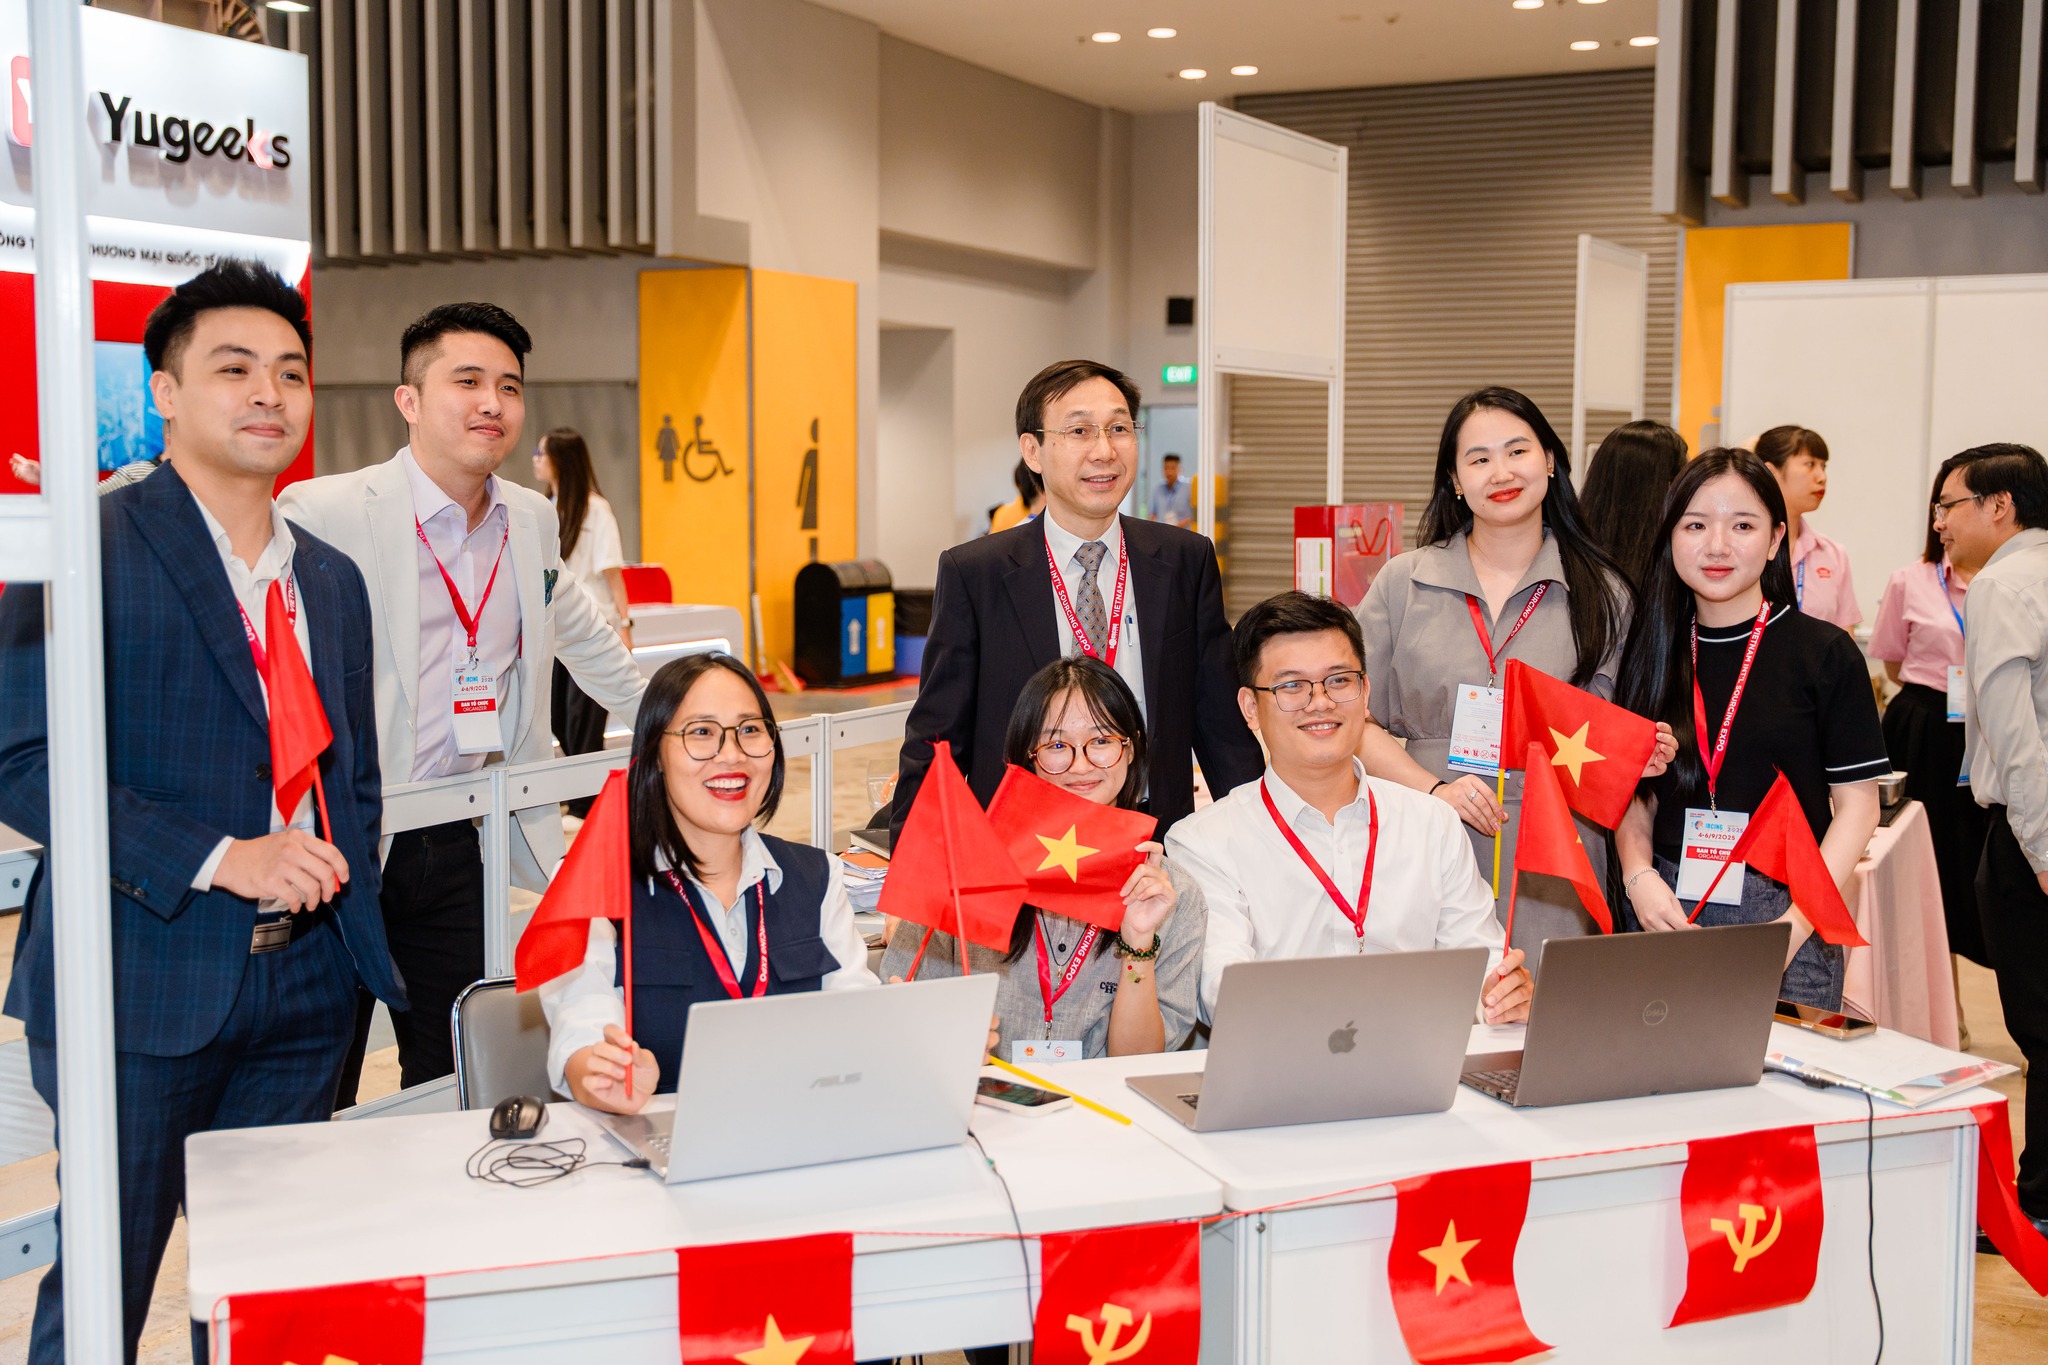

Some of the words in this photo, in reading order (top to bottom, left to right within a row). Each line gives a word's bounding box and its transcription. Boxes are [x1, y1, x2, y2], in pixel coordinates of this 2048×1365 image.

[99, 91, 291, 169] Yugeeks
[1113, 582, 1124, 618] VIETNAM
[1119, 561, 1127, 580] INT'L
[1522, 584, 1546, 619] SOURCING
[1050, 570, 1063, 590] INT'L
[1058, 590, 1078, 629] SOURCING
[1075, 628, 1091, 651] EXPO
[1745, 627, 1762, 662] VIETNAM
[1738, 664, 1750, 684] INT'L
[1724, 685, 1742, 727] SOURCING
[1716, 728, 1728, 752] EXPO
[1698, 853, 1729, 861] ORGANIZE
[1078, 923, 1098, 957] URCING
[760, 956, 768, 982] EXPO
[1066, 957, 1082, 981] EXPO
